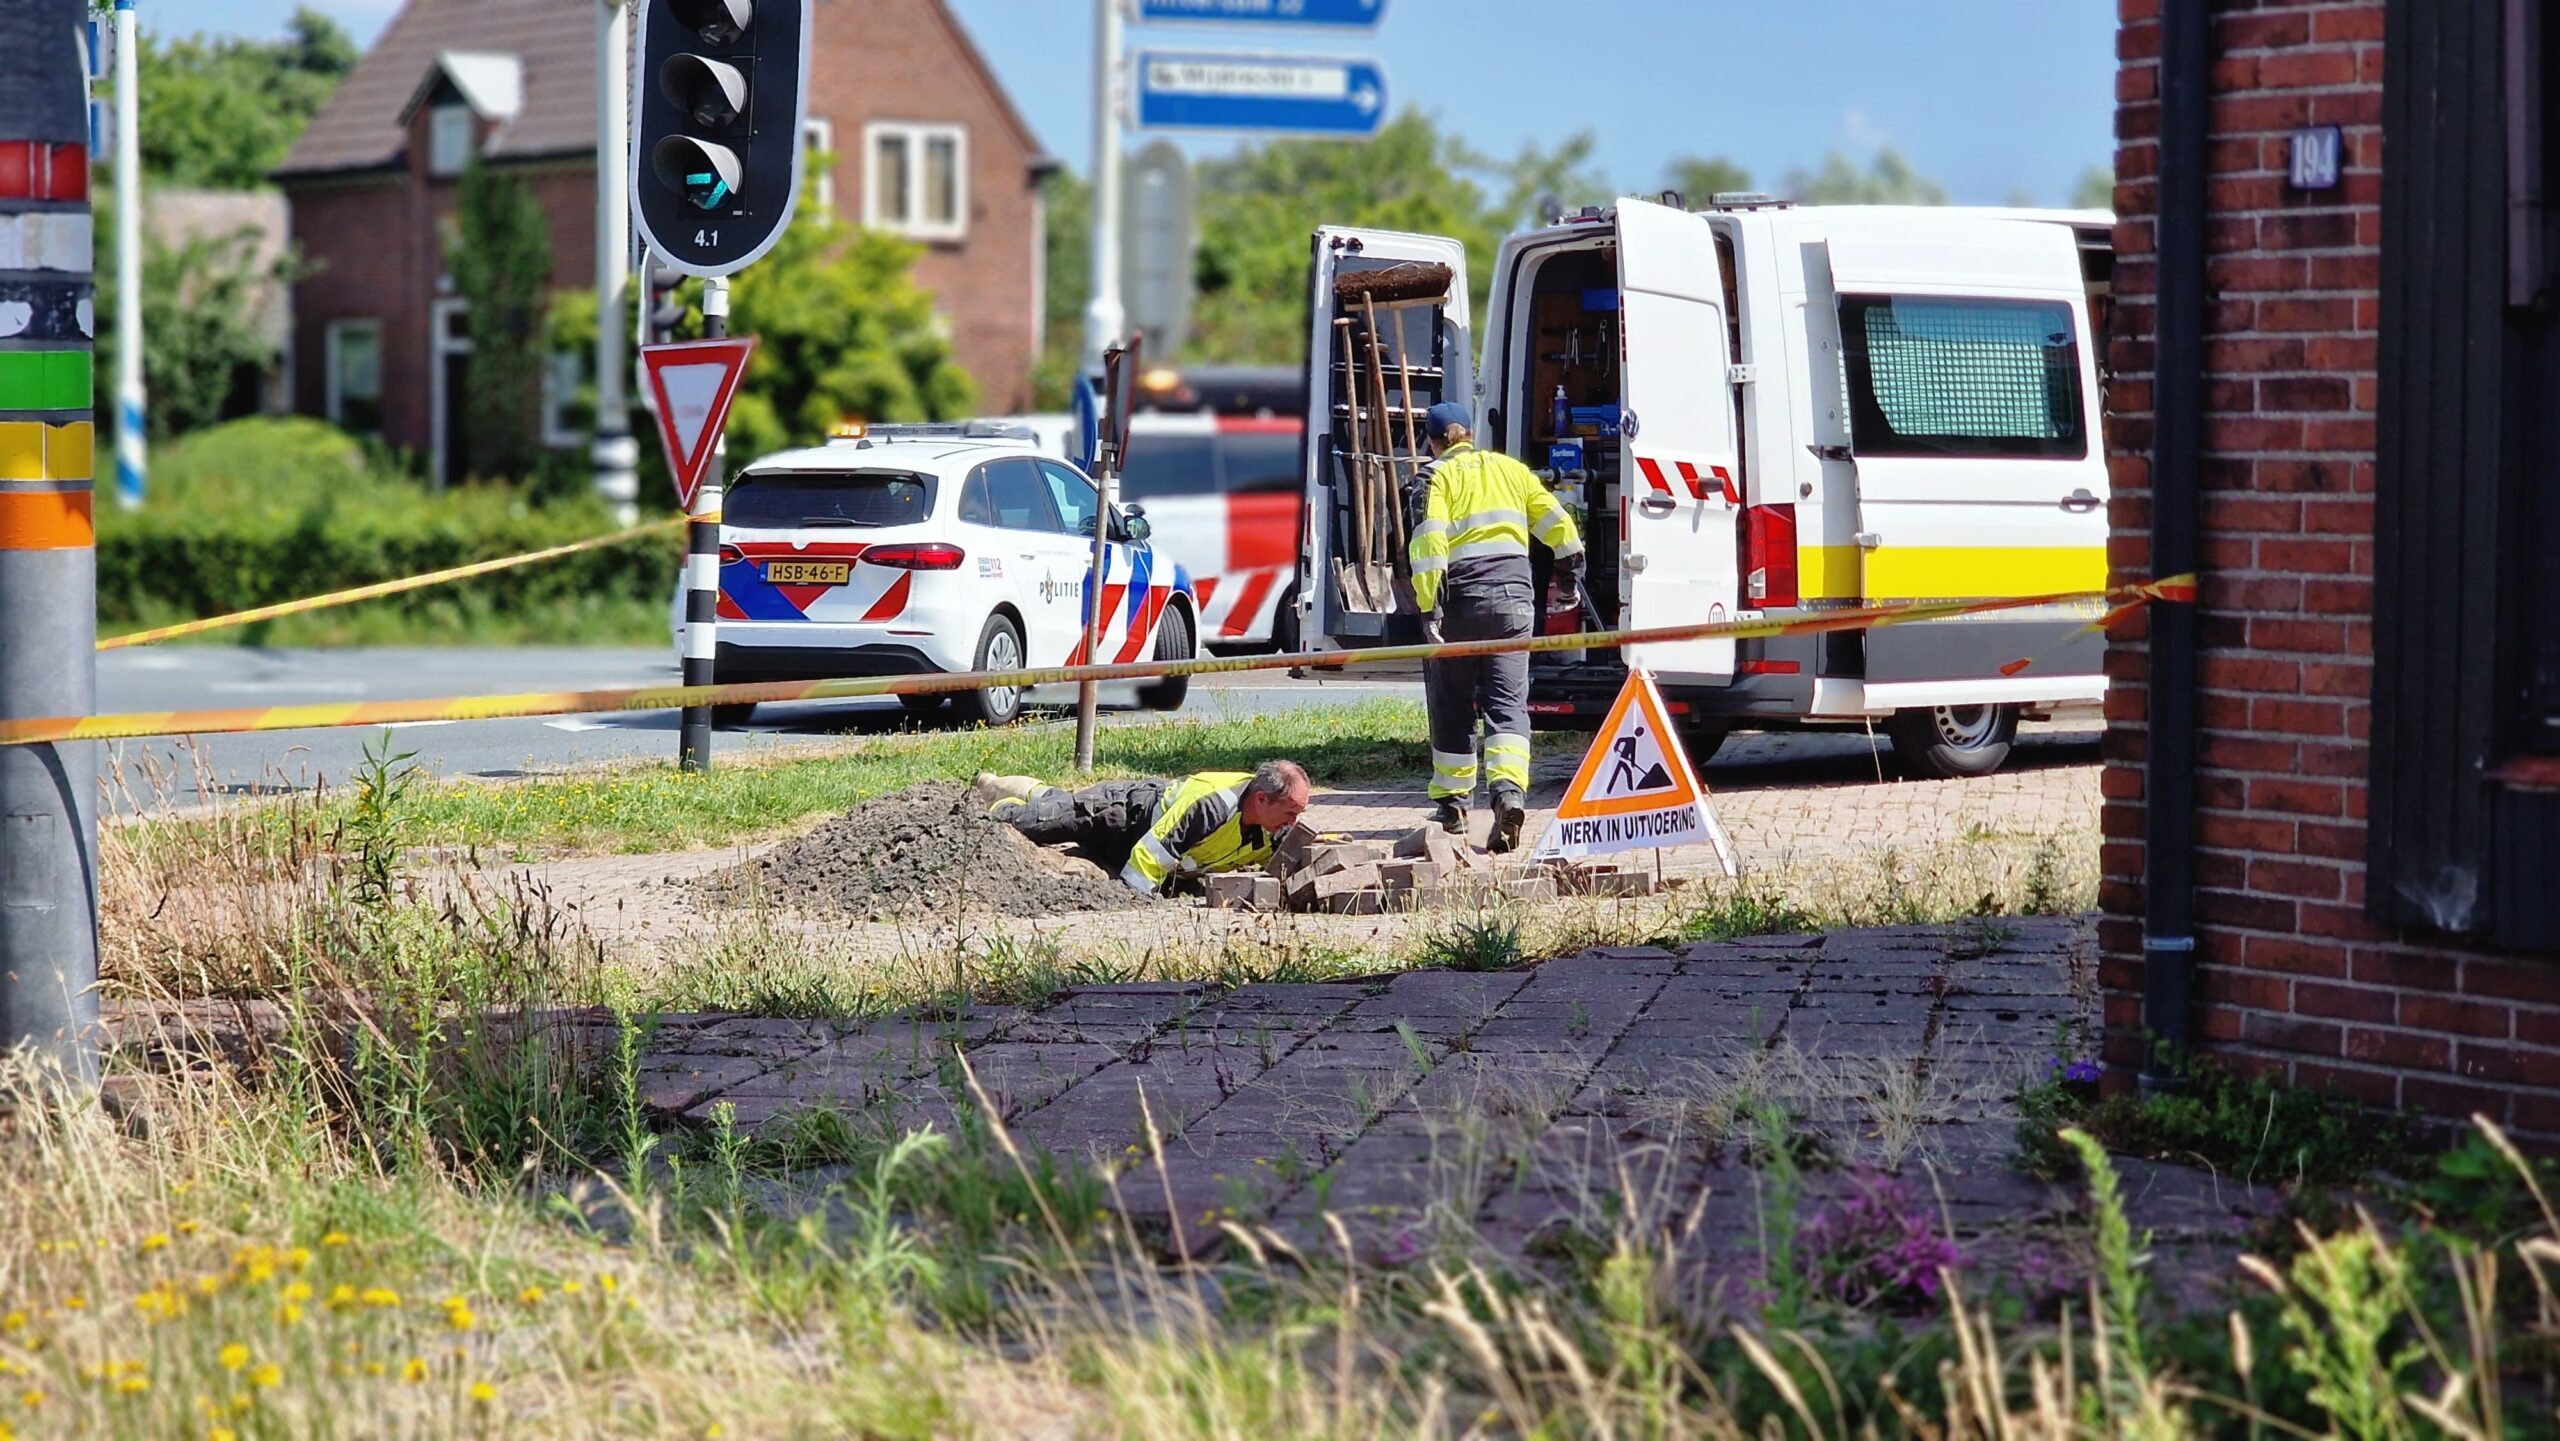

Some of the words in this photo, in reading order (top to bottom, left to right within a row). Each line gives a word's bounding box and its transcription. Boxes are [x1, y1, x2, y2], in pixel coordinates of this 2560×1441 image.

[2291, 133, 2335, 183] 194
[694, 230, 718, 246] 4.1
[773, 565, 844, 580] HSB-46-F
[1561, 819, 1602, 846] WERK
[1607, 818, 1620, 842] IN
[1624, 806, 1696, 840] UITVOERING
